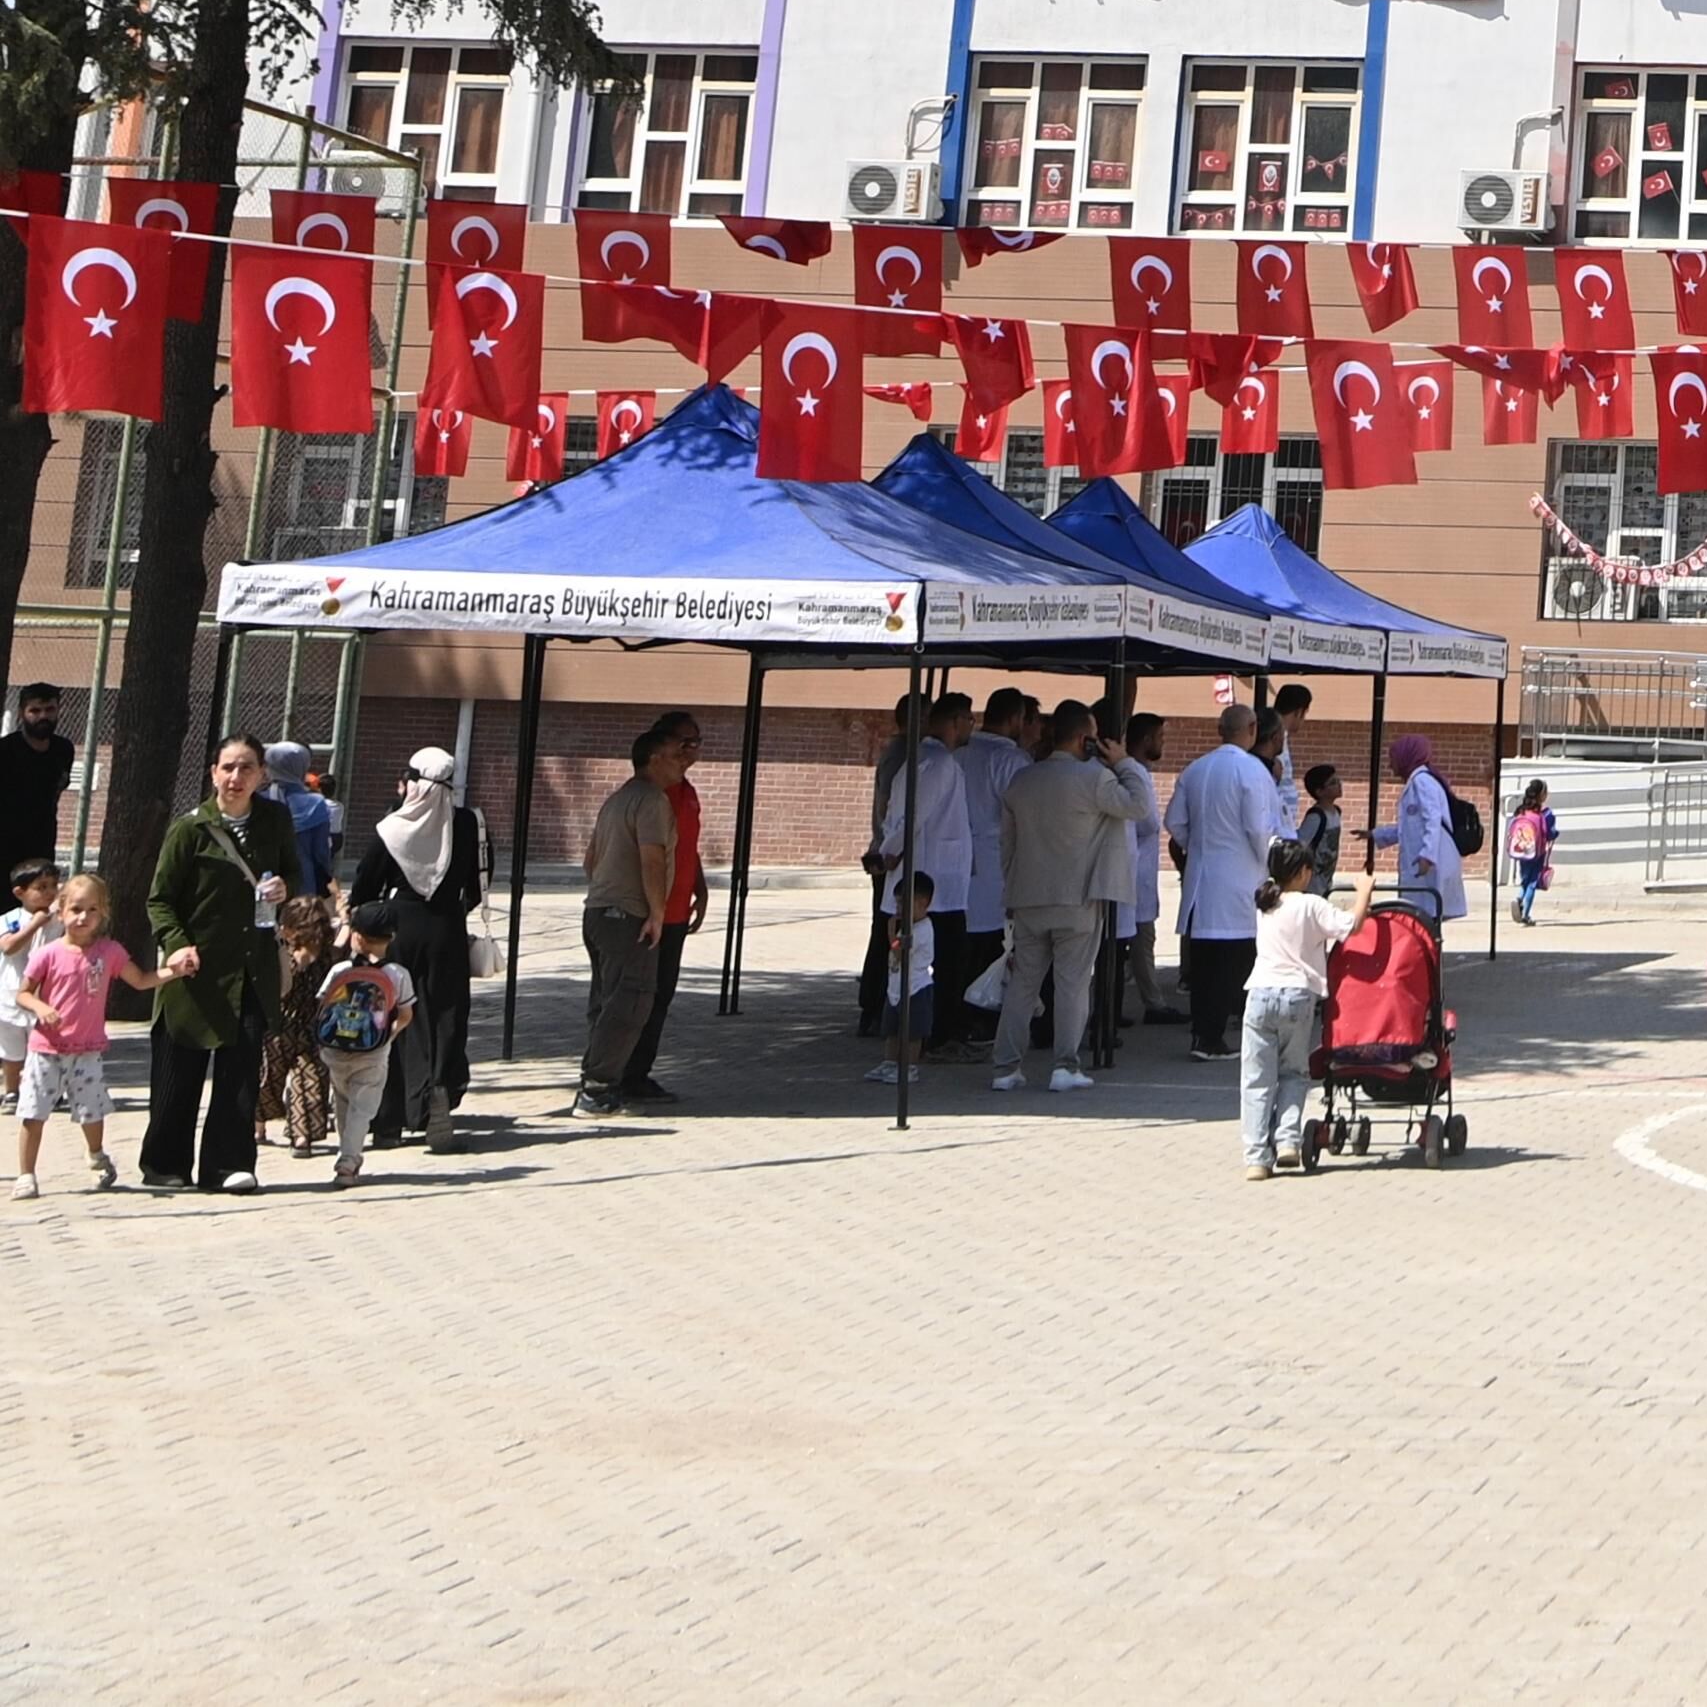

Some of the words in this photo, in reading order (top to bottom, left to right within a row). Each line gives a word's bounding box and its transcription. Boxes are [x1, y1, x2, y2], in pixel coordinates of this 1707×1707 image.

[903, 167, 919, 213] VESTEL
[1521, 177, 1534, 224] VESTEL
[369, 581, 553, 623] Kahramanmaraş
[561, 588, 669, 626] Büyükşehir
[675, 589, 772, 628] Belediyesi
[798, 601, 883, 615] Kahramanmaraş
